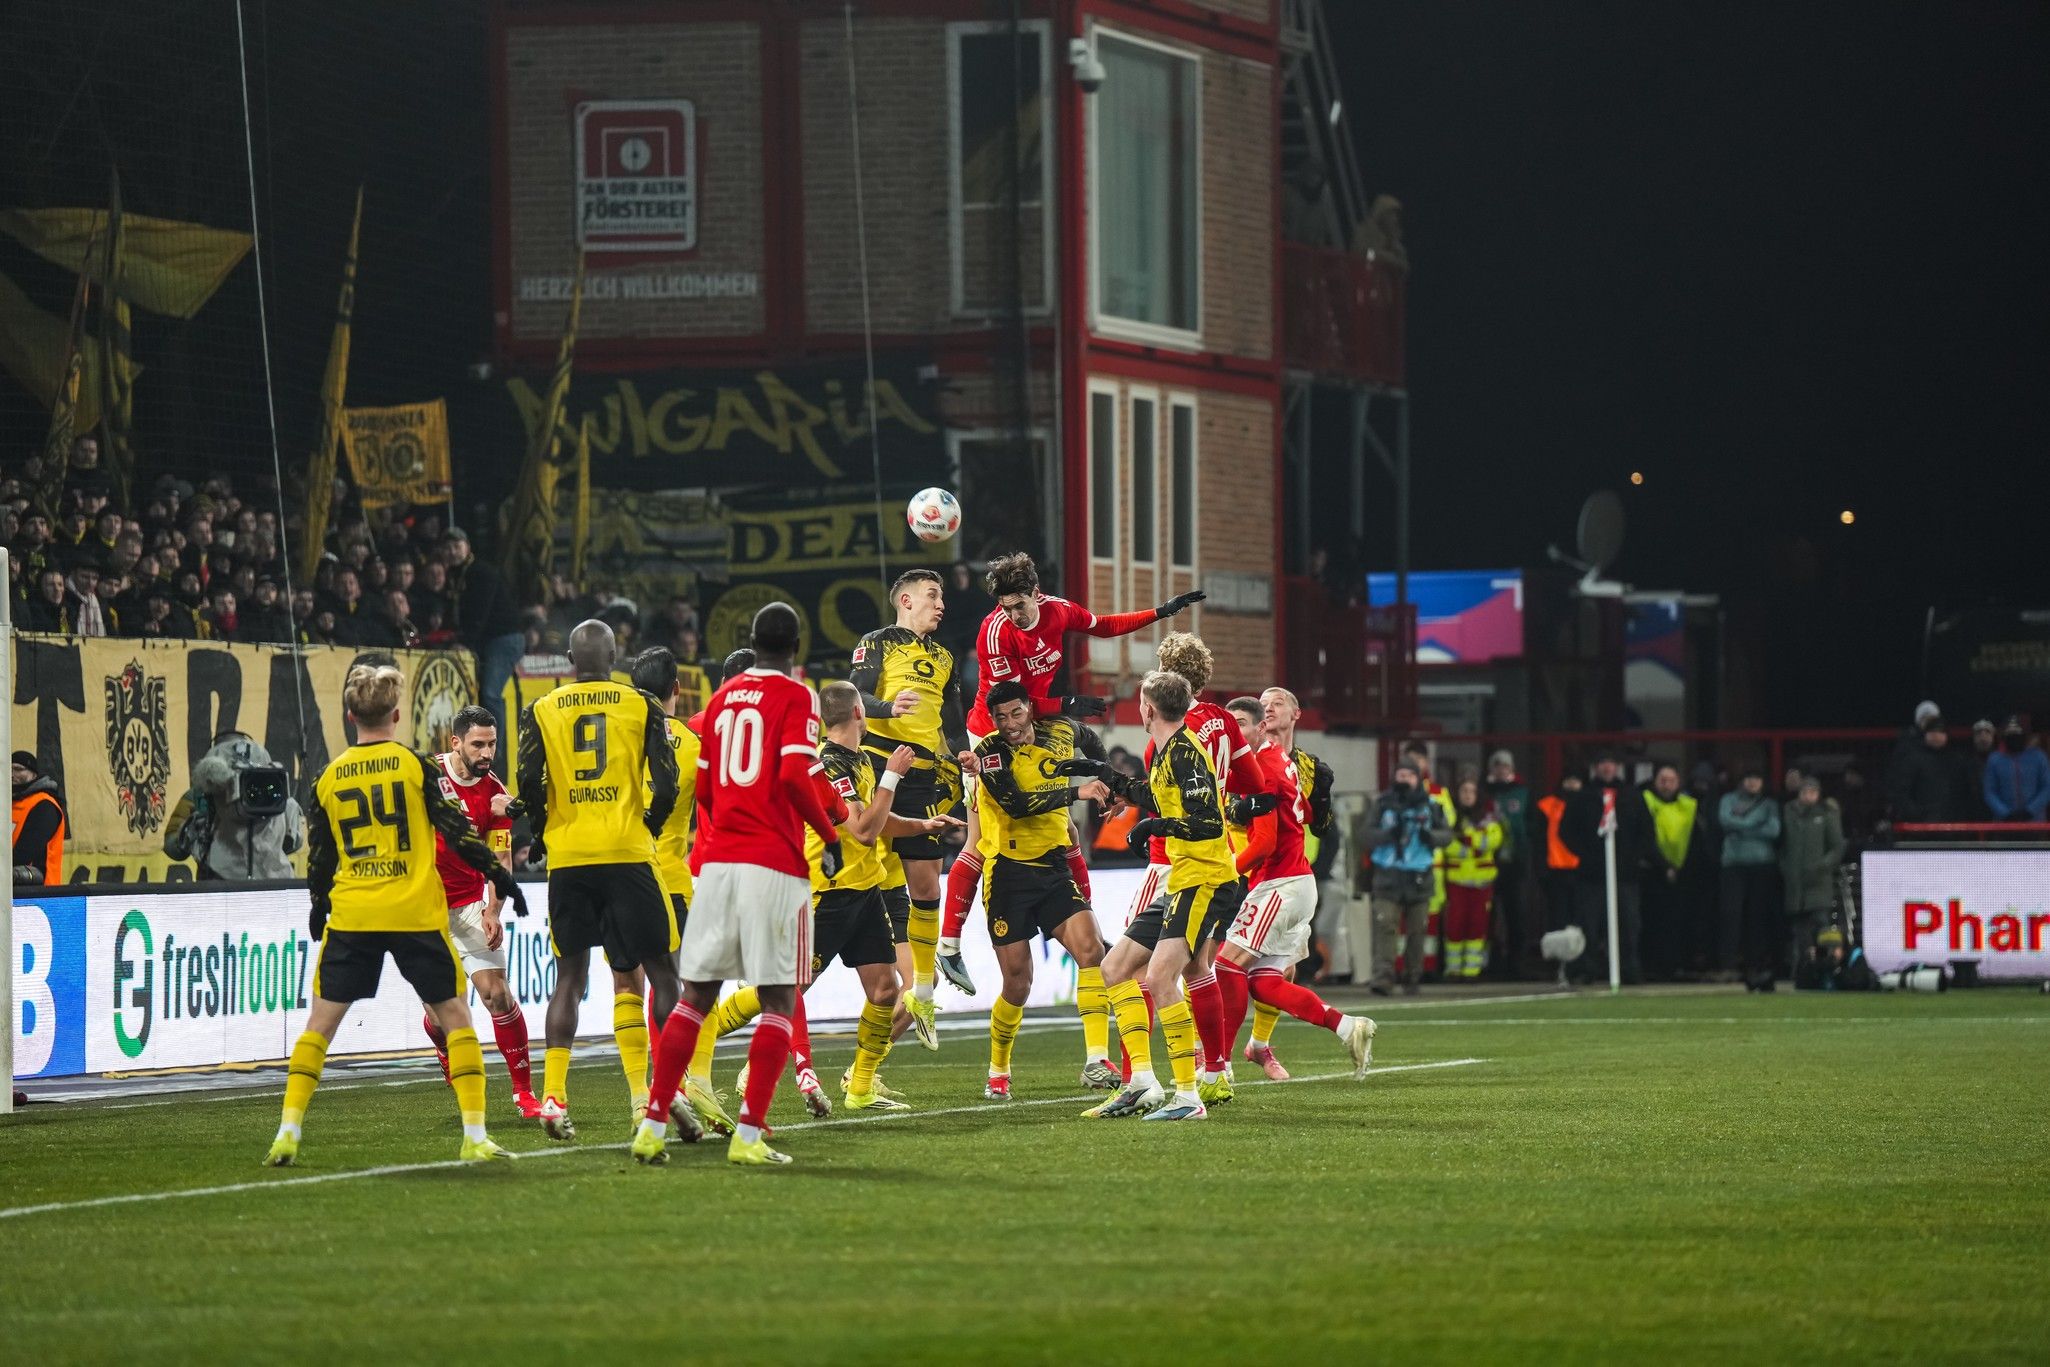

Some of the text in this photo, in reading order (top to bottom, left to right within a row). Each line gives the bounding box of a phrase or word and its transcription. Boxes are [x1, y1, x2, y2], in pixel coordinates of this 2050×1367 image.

[583, 197, 687, 221] FÖRSTEREI
[520, 272, 758, 298] HERZICH WILLKOMMEN
[557, 690, 621, 709] DORTMUND
[723, 688, 764, 706] ANSAH
[127, 723, 150, 767] BVB
[573, 712, 608, 781] 9
[714, 707, 765, 788] 10
[336, 756, 400, 780] DORTMUND
[569, 785, 619, 804] GUIRASSY
[334, 780, 411, 859] 24
[350, 860, 408, 877] SVENSSON
[1236, 901, 1259, 926] 23
[162, 929, 309, 1020] freshfoodz
